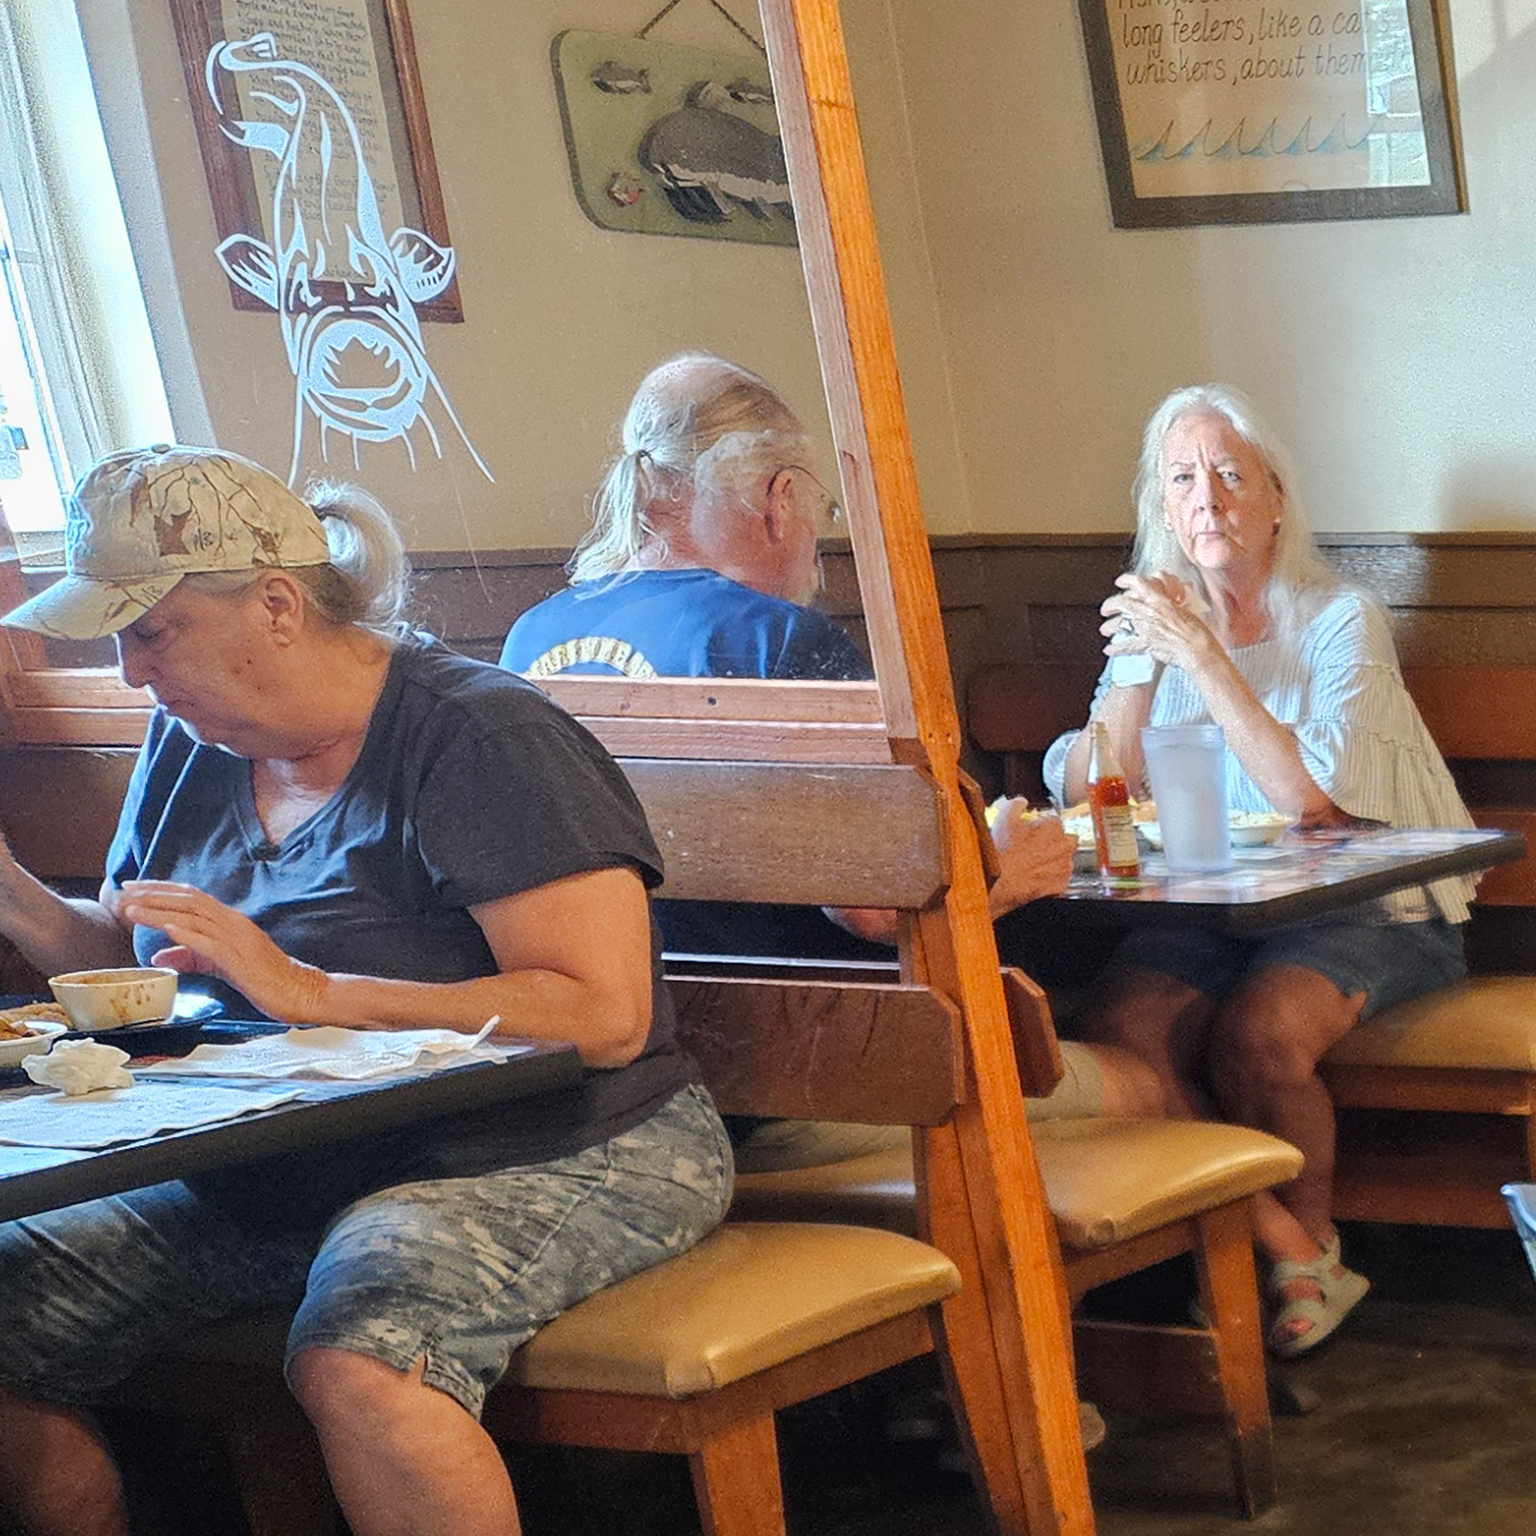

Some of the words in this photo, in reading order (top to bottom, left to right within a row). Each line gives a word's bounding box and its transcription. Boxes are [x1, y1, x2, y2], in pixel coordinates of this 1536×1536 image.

[1123, 13, 1163, 59] long
[1258, 7, 1301, 41] like
[1308, 14, 1324, 36] a
[1241, 45, 1305, 80] about
